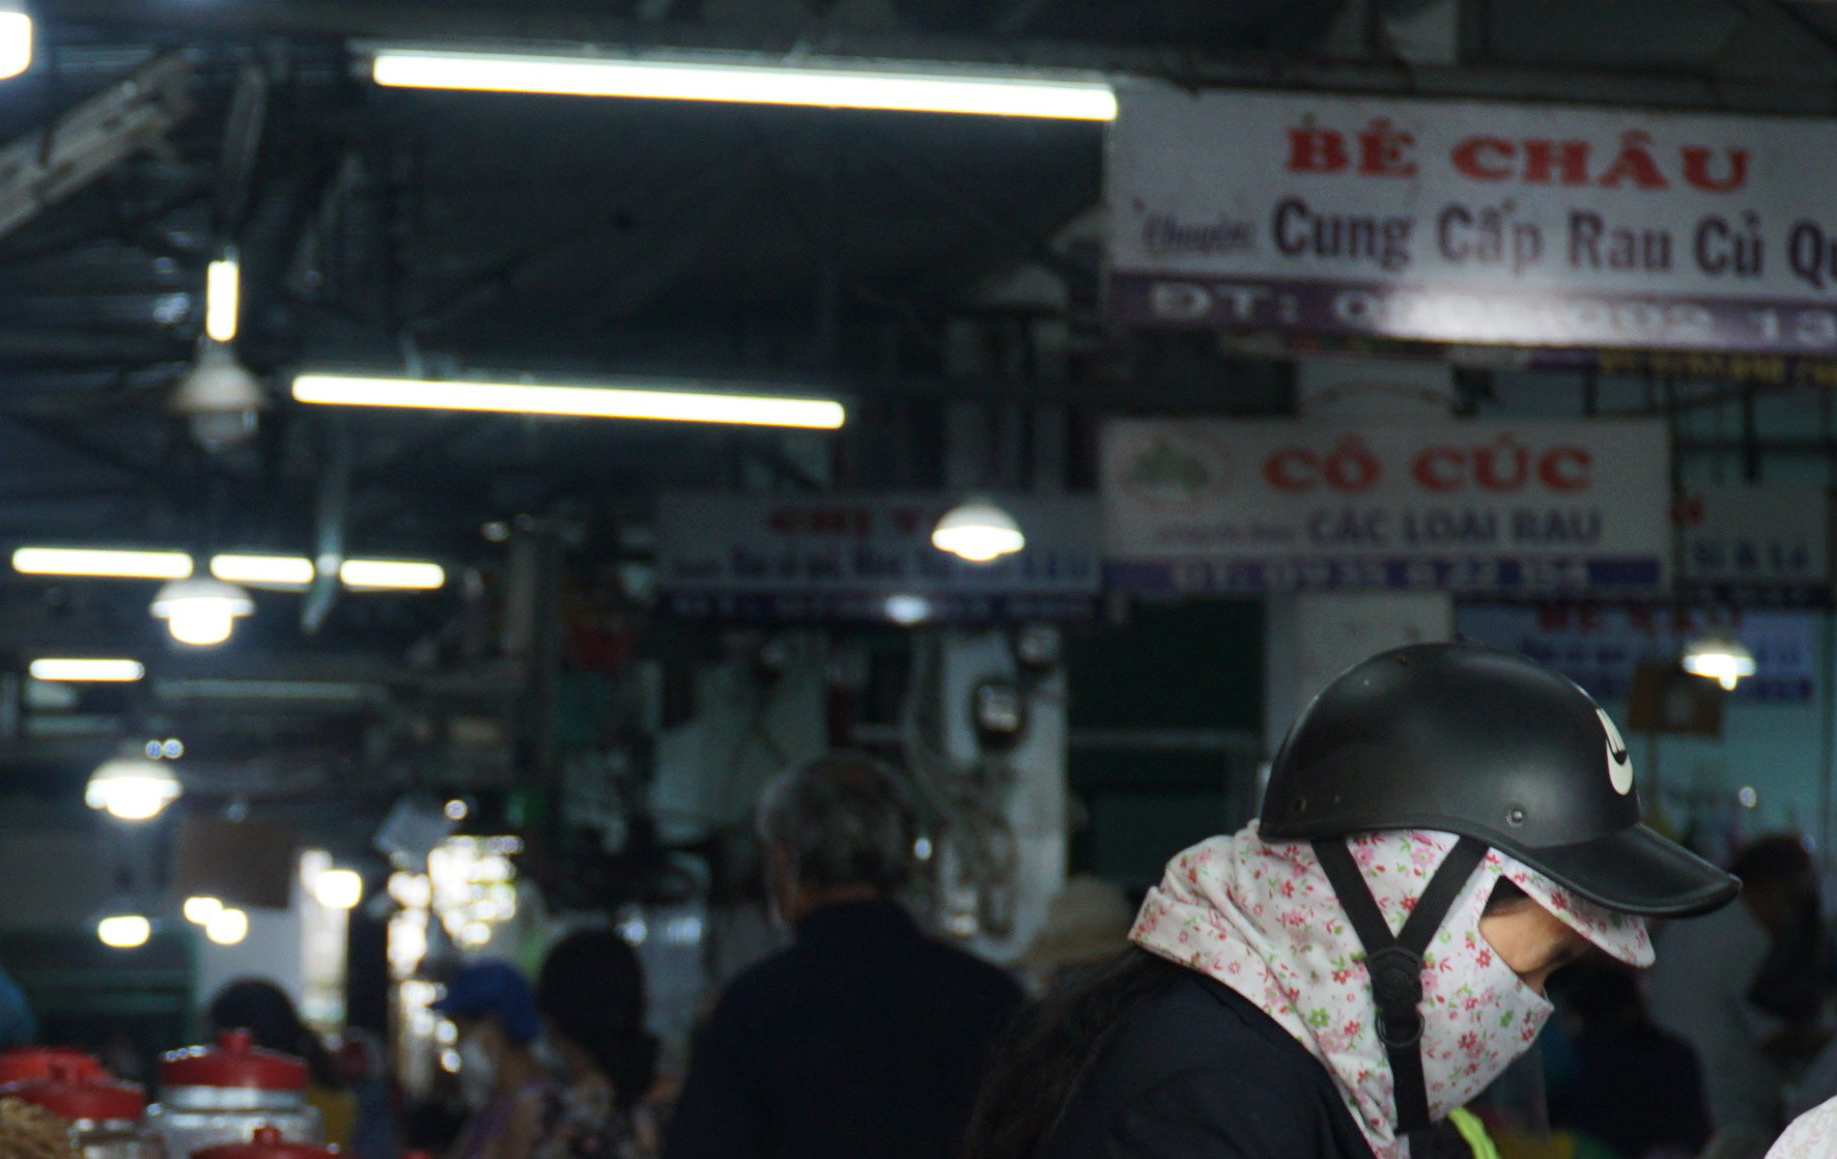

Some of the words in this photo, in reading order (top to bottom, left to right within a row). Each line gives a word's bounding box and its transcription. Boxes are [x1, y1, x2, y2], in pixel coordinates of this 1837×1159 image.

[1451, 129, 1751, 194] CHÂU
[1273, 196, 1414, 272] Cung
[1436, 200, 1545, 276] Cấp
[1567, 207, 1673, 272] Rau
[1694, 209, 1765, 277] Củ
[1261, 433, 1381, 494] CÔ
[1411, 433, 1594, 494] CÚC
